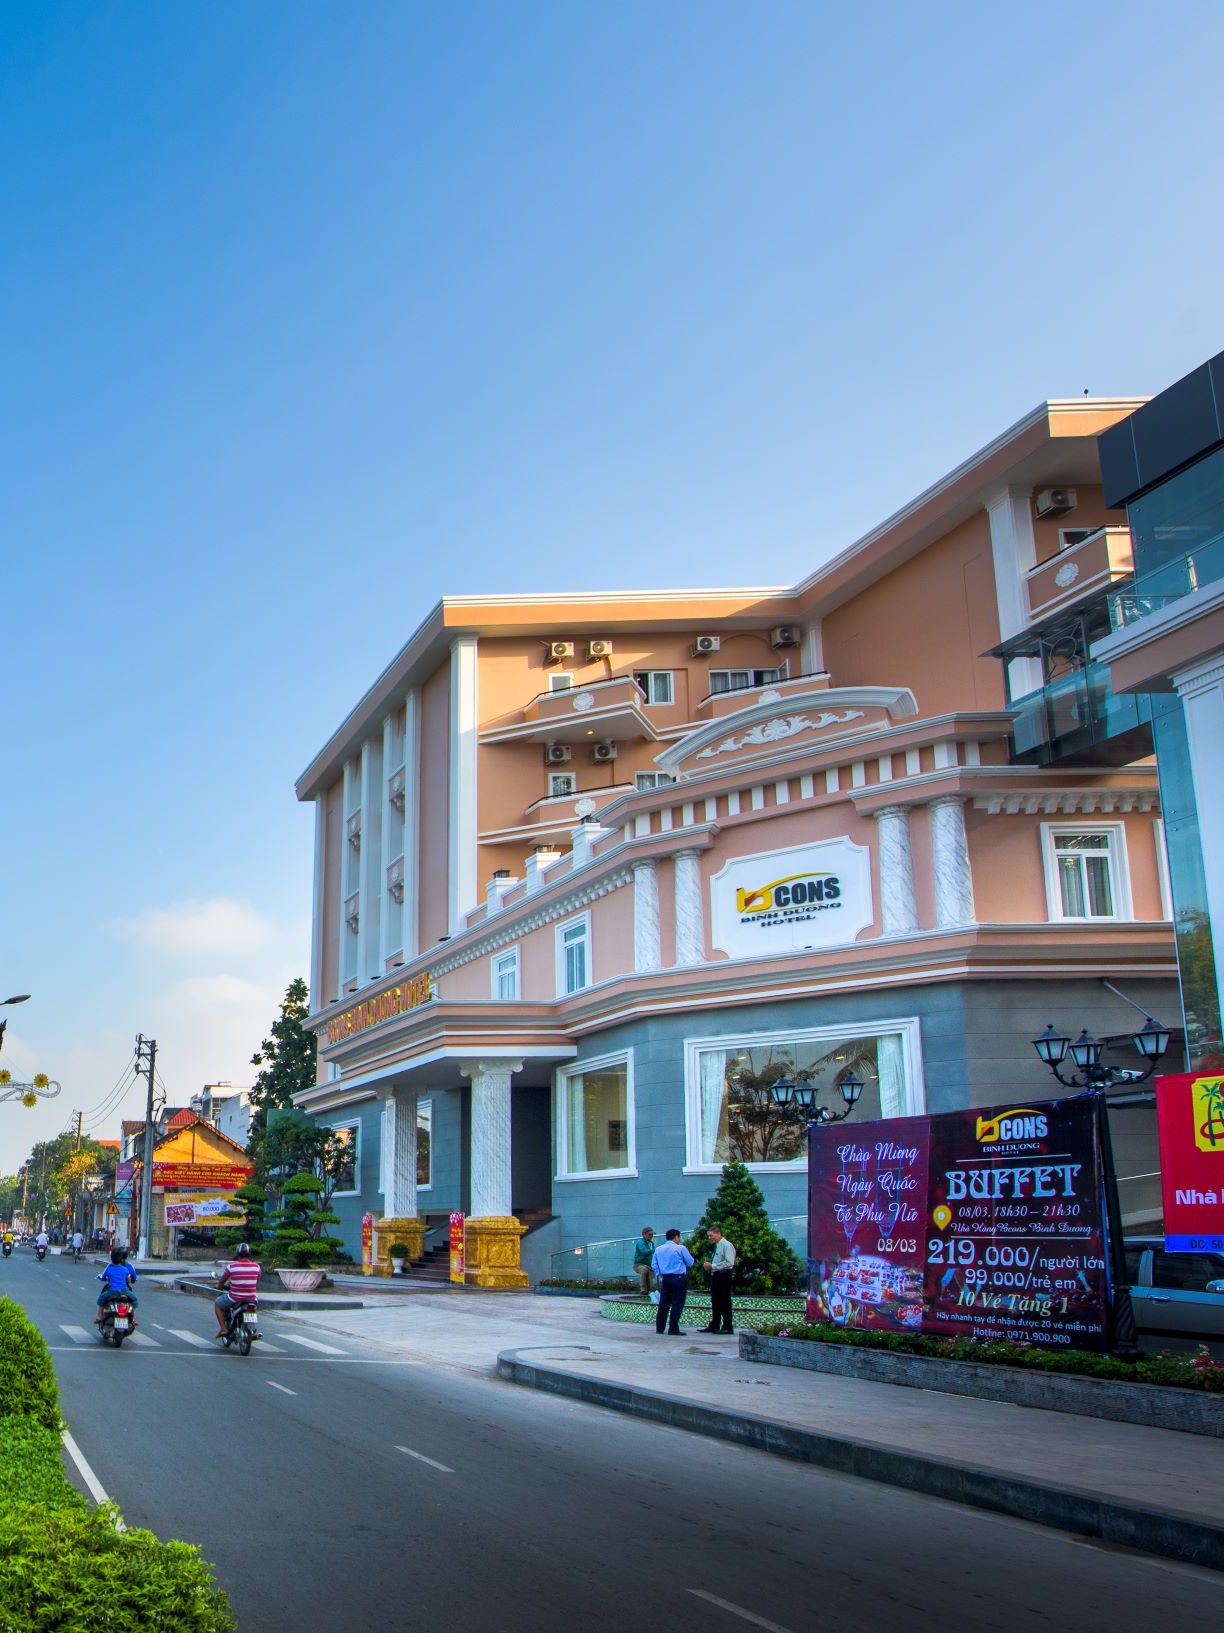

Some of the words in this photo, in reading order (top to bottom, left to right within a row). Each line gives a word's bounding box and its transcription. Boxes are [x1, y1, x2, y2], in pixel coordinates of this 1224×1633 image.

[741, 912, 779, 923] BINH
[783, 902, 842, 917] DUONG
[761, 914, 816, 927] HOTEL
[837, 1144, 872, 1162] Chào
[875, 1142, 919, 1166] Mừng
[836, 1174, 874, 1198] Ngày
[877, 1171, 918, 1197] Quốc
[945, 1164, 1082, 1200] BUFFET
[1176, 1189, 1218, 1205] Nhà
[1042, 1201, 1080, 1216] 21h30
[878, 1238, 917, 1253] 08/03
[1055, 1278, 1076, 1289] em
[956, 1290, 975, 1307] 10
[981, 1291, 1002, 1309] Vé
[1007, 1293, 1053, 1317] Tặng
[1059, 1297, 1069, 1314] 1
[950, 1313, 973, 1321] nhanh
[974, 1316, 985, 1324] tay
[1041, 1320, 1052, 1328] 20
[1053, 1321, 1063, 1329] vé
[973, 1327, 1005, 1338] Hotline:
